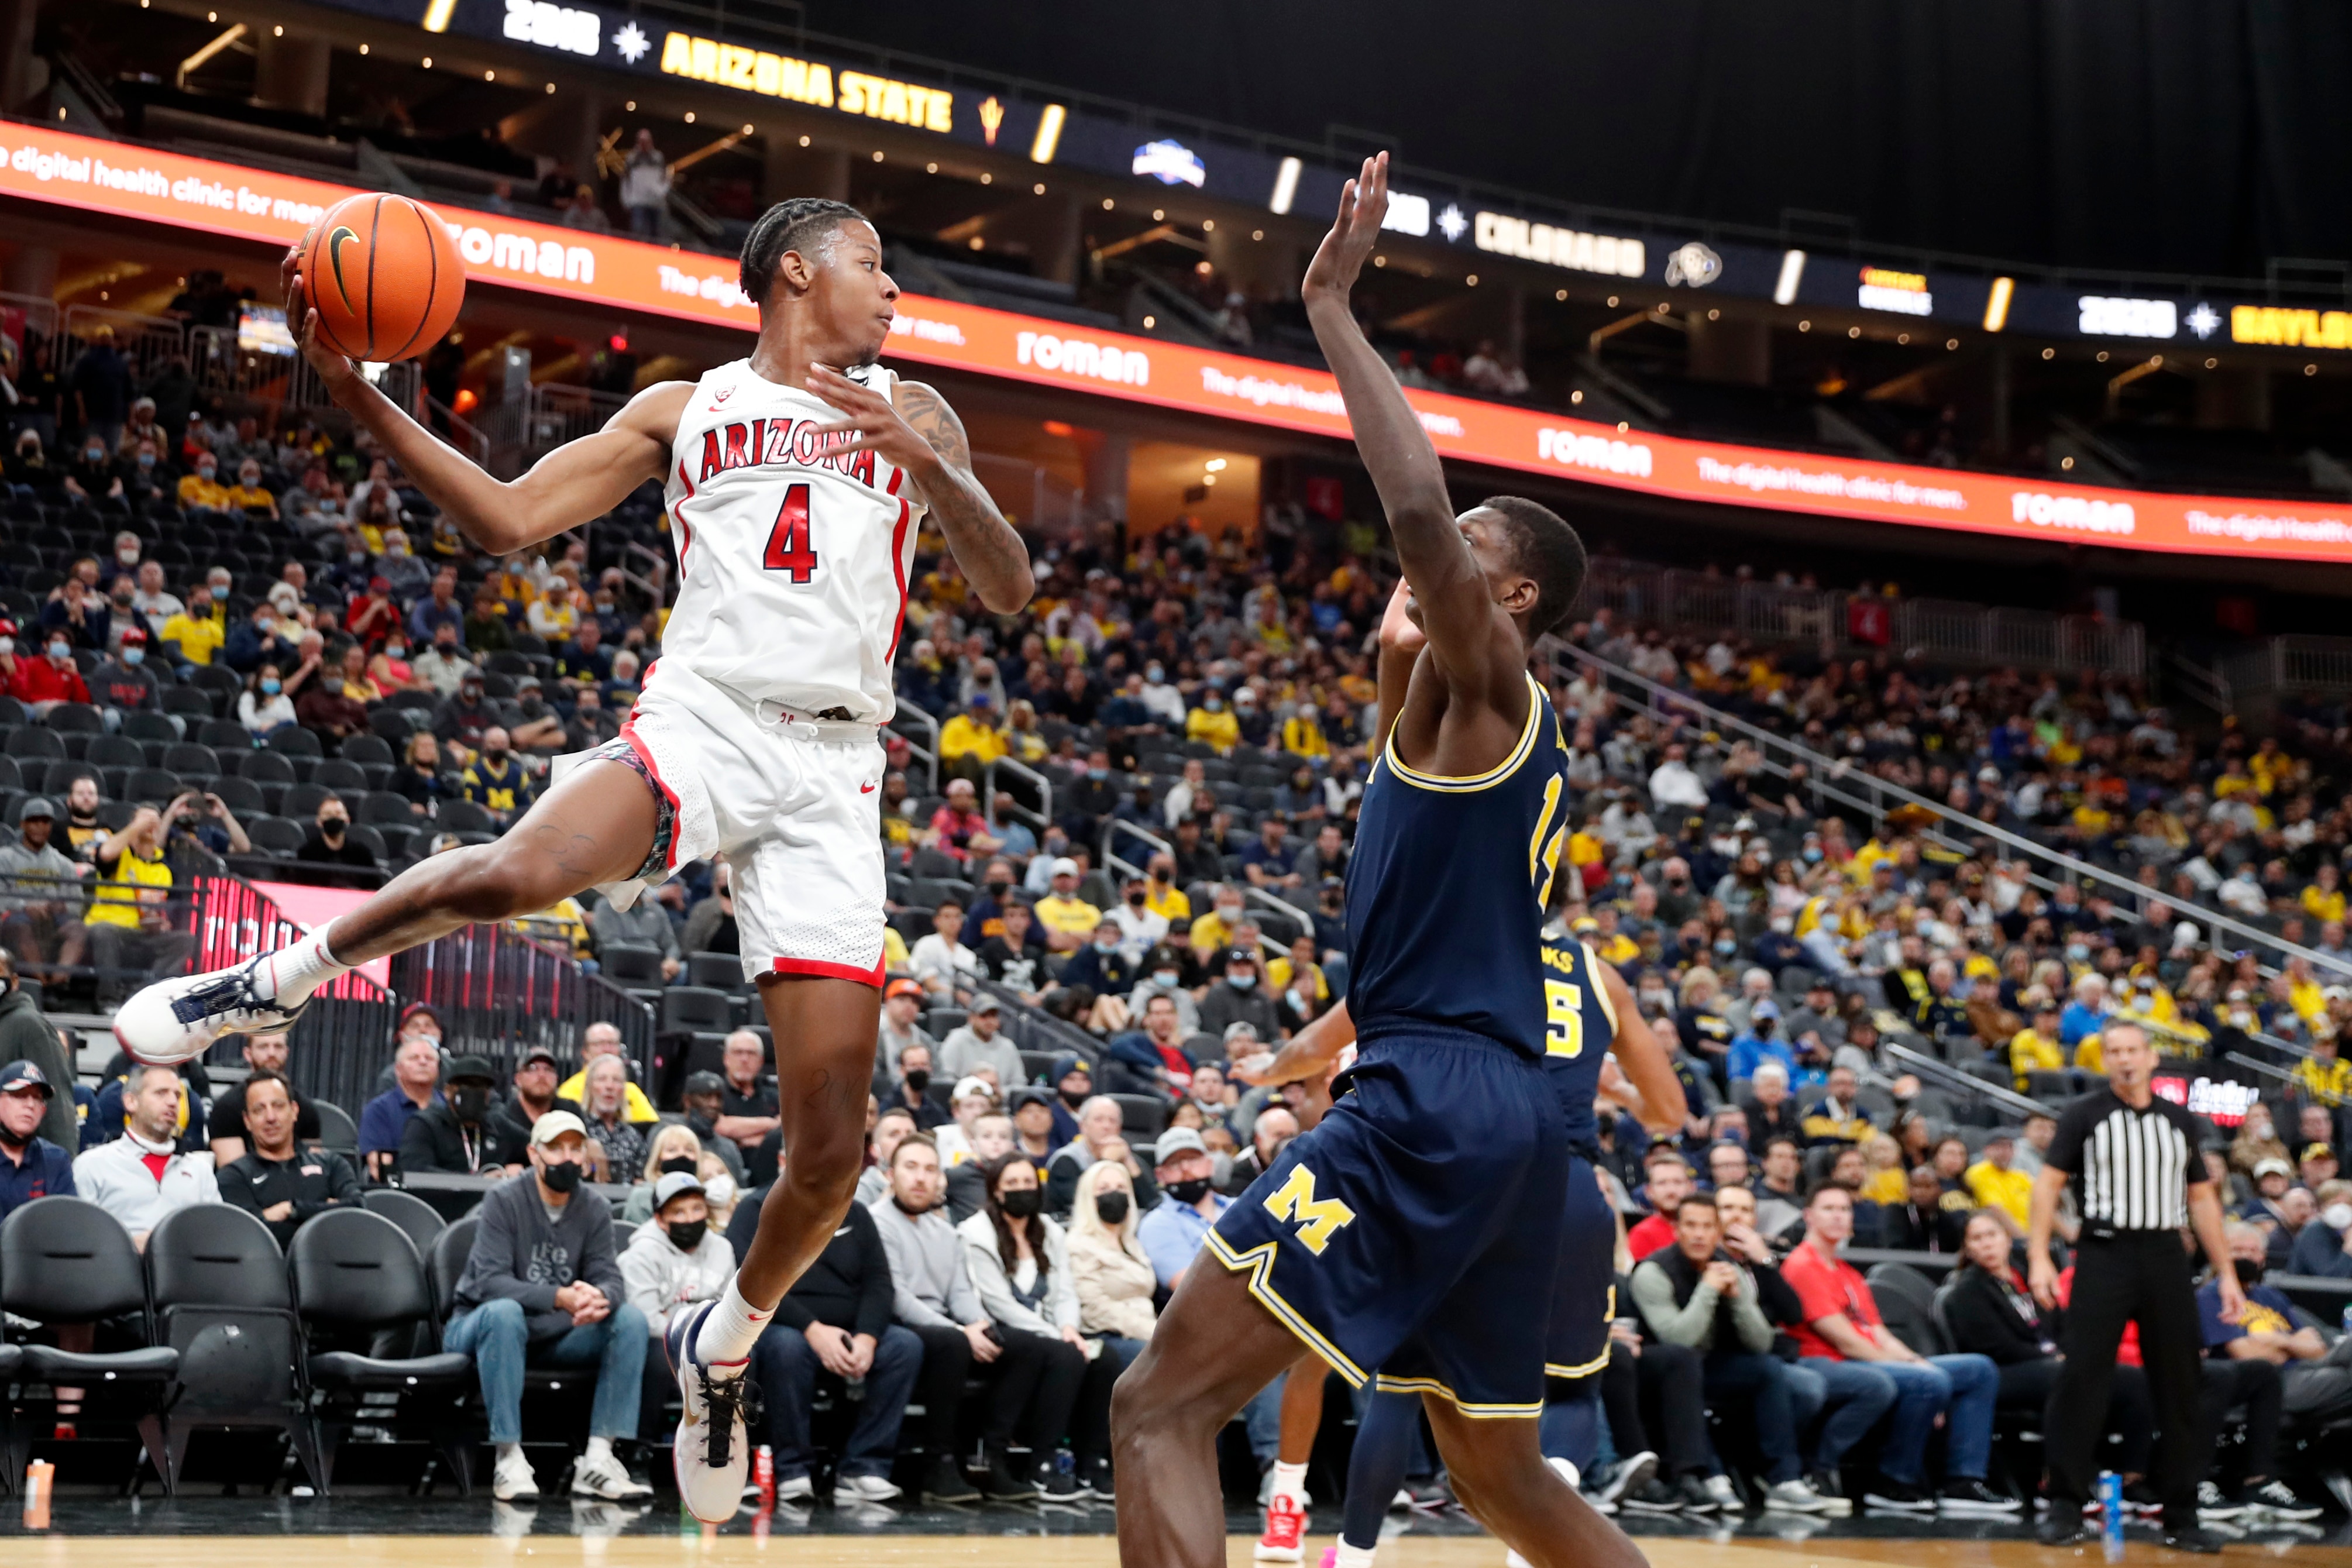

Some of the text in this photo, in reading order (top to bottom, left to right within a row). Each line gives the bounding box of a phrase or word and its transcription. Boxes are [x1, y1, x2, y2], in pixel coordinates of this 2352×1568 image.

[660, 31, 953, 134] ARIZONA STATE
[11, 145, 91, 183] digital
[94, 159, 169, 198] health
[172, 176, 235, 210] clinic
[236, 186, 272, 216] for
[656, 265, 699, 297] The
[1016, 331, 1150, 387] roman
[700, 418, 876, 489] ARIZONA
[1538, 428, 1653, 477] roman
[763, 483, 818, 584] 4
[2011, 491, 2135, 535] roman
[1263, 1163, 1356, 1256] M
